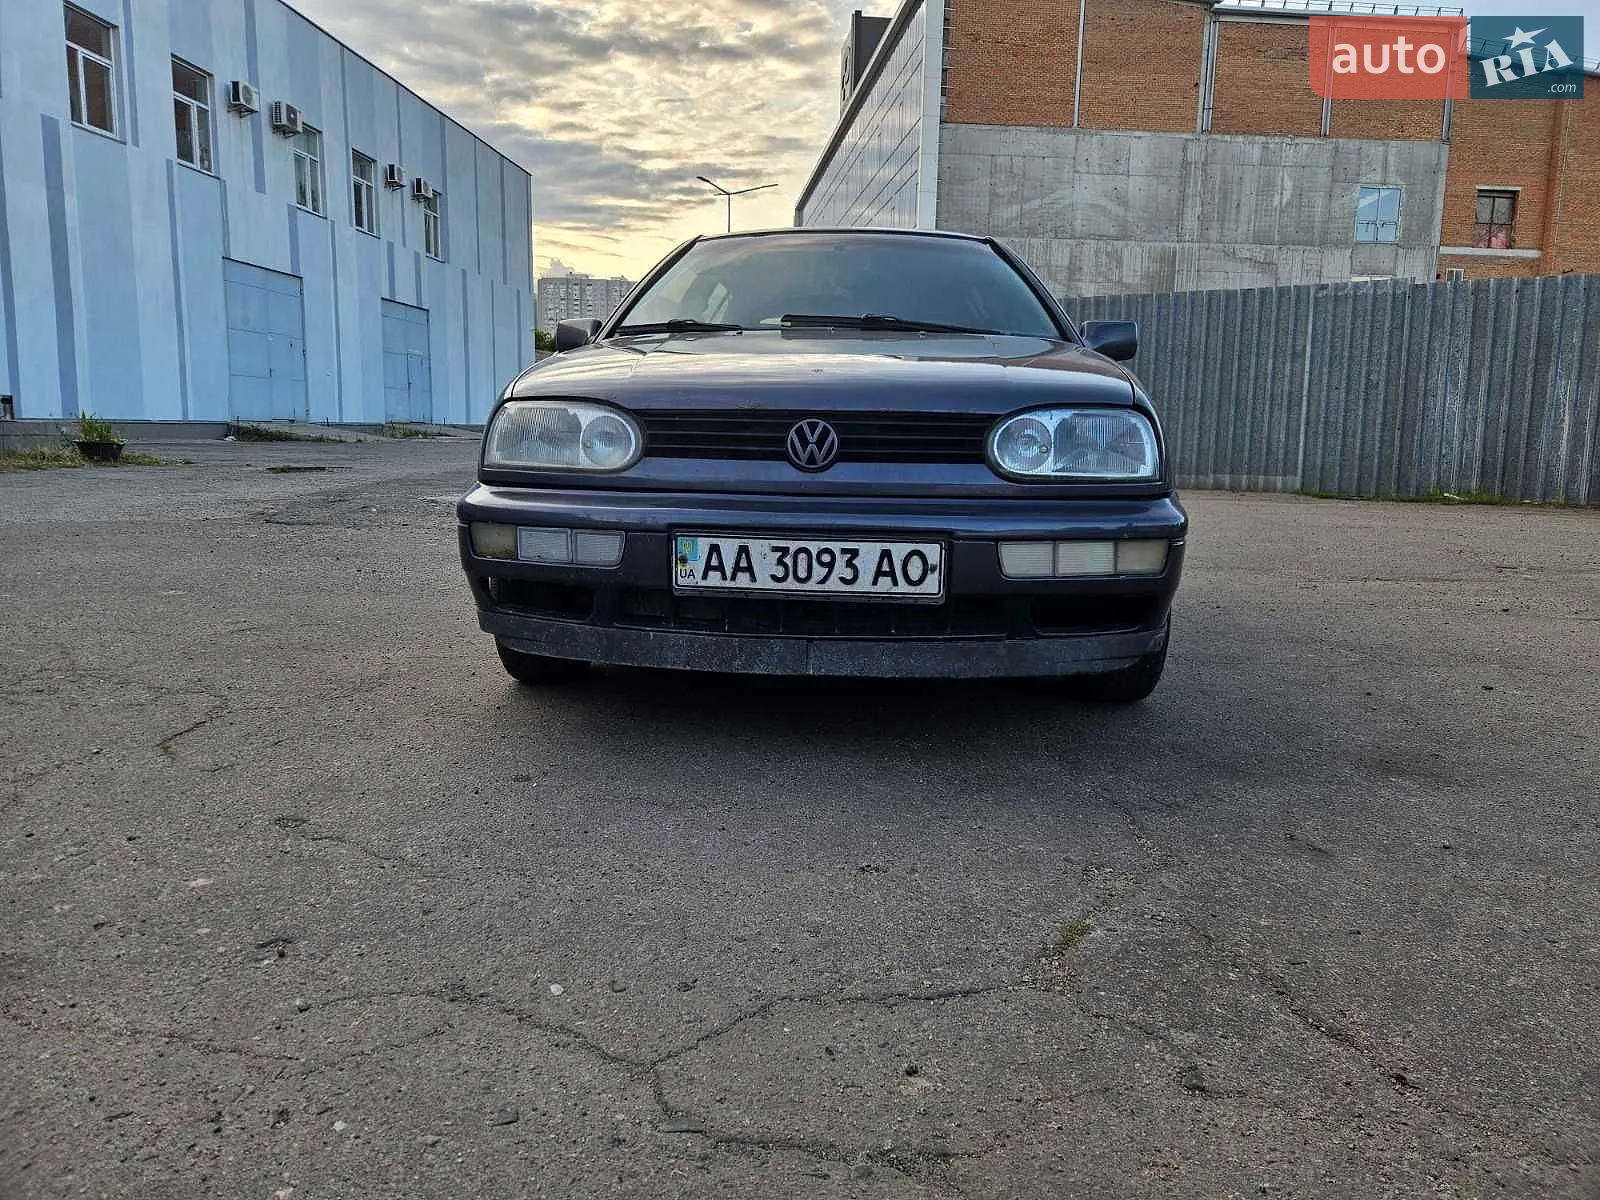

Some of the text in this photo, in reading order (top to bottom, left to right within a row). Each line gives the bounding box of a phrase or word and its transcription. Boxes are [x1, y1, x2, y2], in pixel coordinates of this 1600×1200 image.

[679, 568, 696, 580] UA
[701, 543, 930, 587] AA 3093 AO
